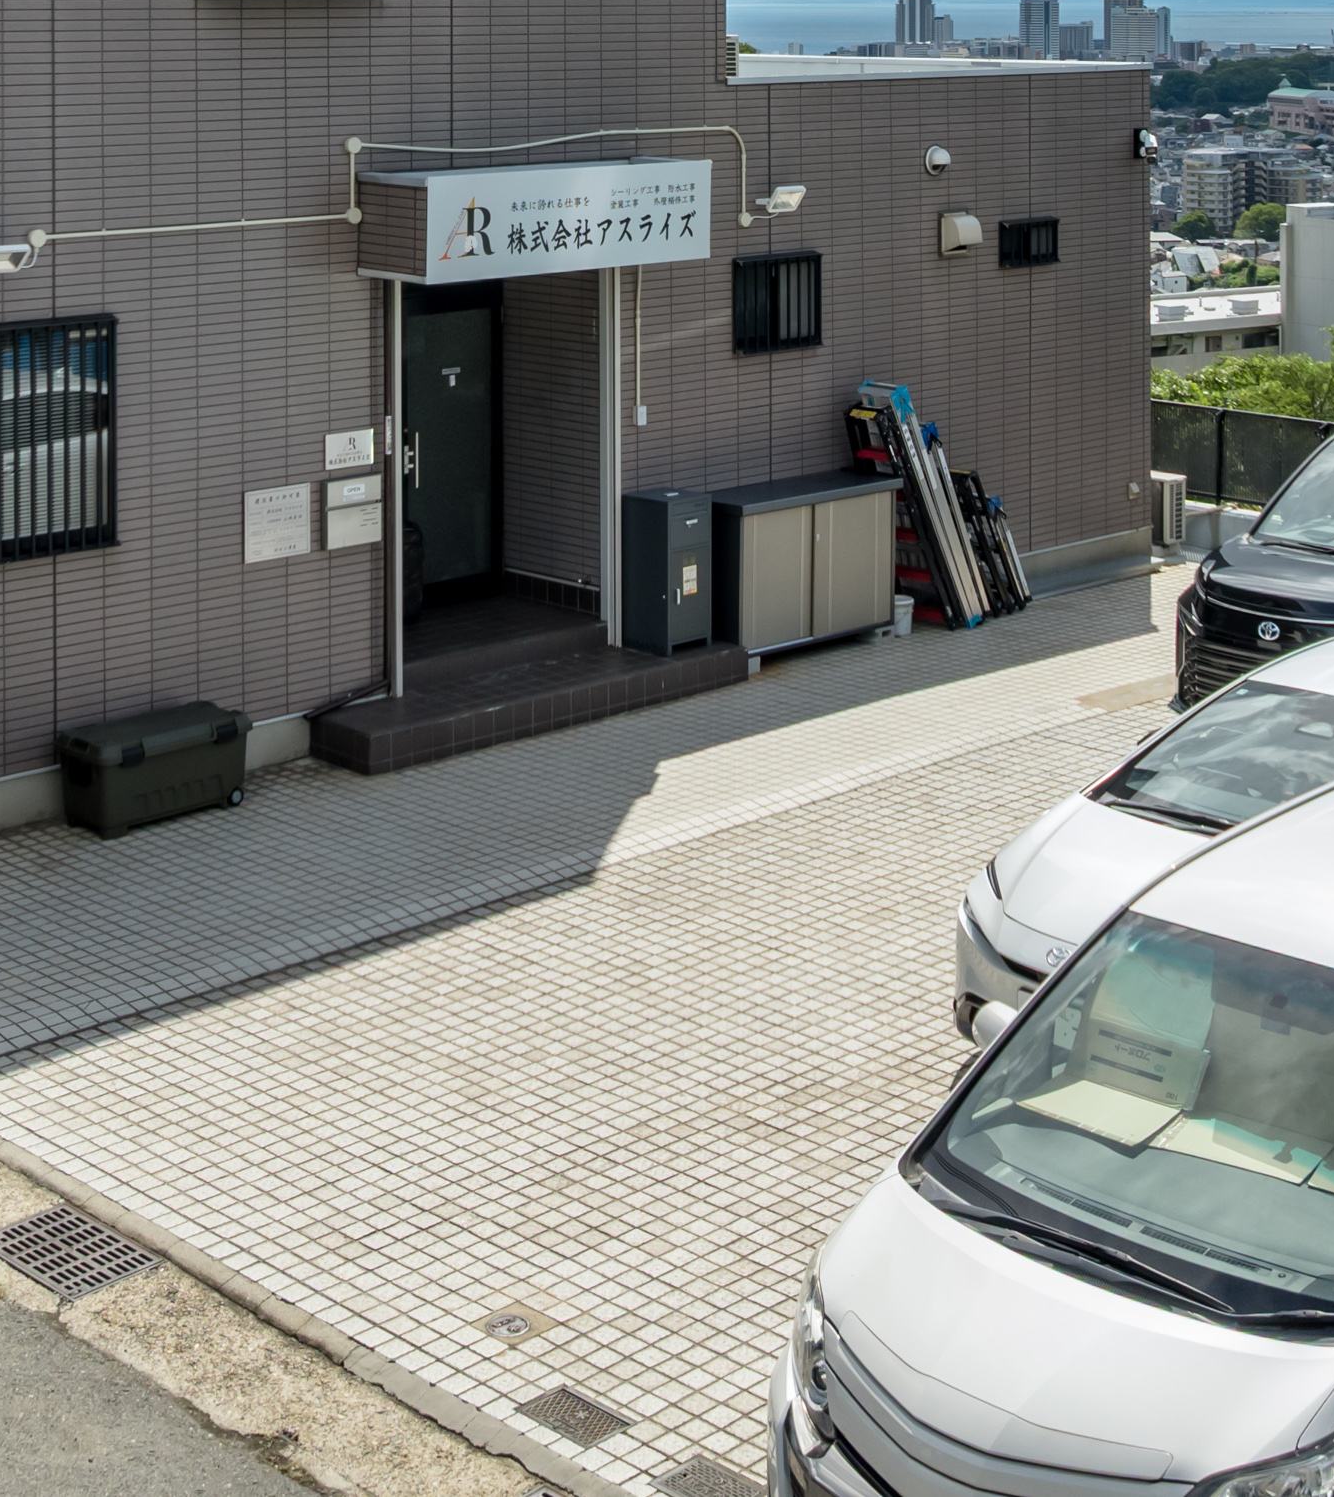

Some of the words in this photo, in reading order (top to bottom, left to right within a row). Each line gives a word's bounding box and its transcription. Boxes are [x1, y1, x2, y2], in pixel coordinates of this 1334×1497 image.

[611, 185, 660, 197] シーリング工事
[668, 183, 695, 193] 防水工事
[510, 196, 590, 212] 未来に誇れる仕事を
[507, 210, 697, 255] 株式会社アスライズ
